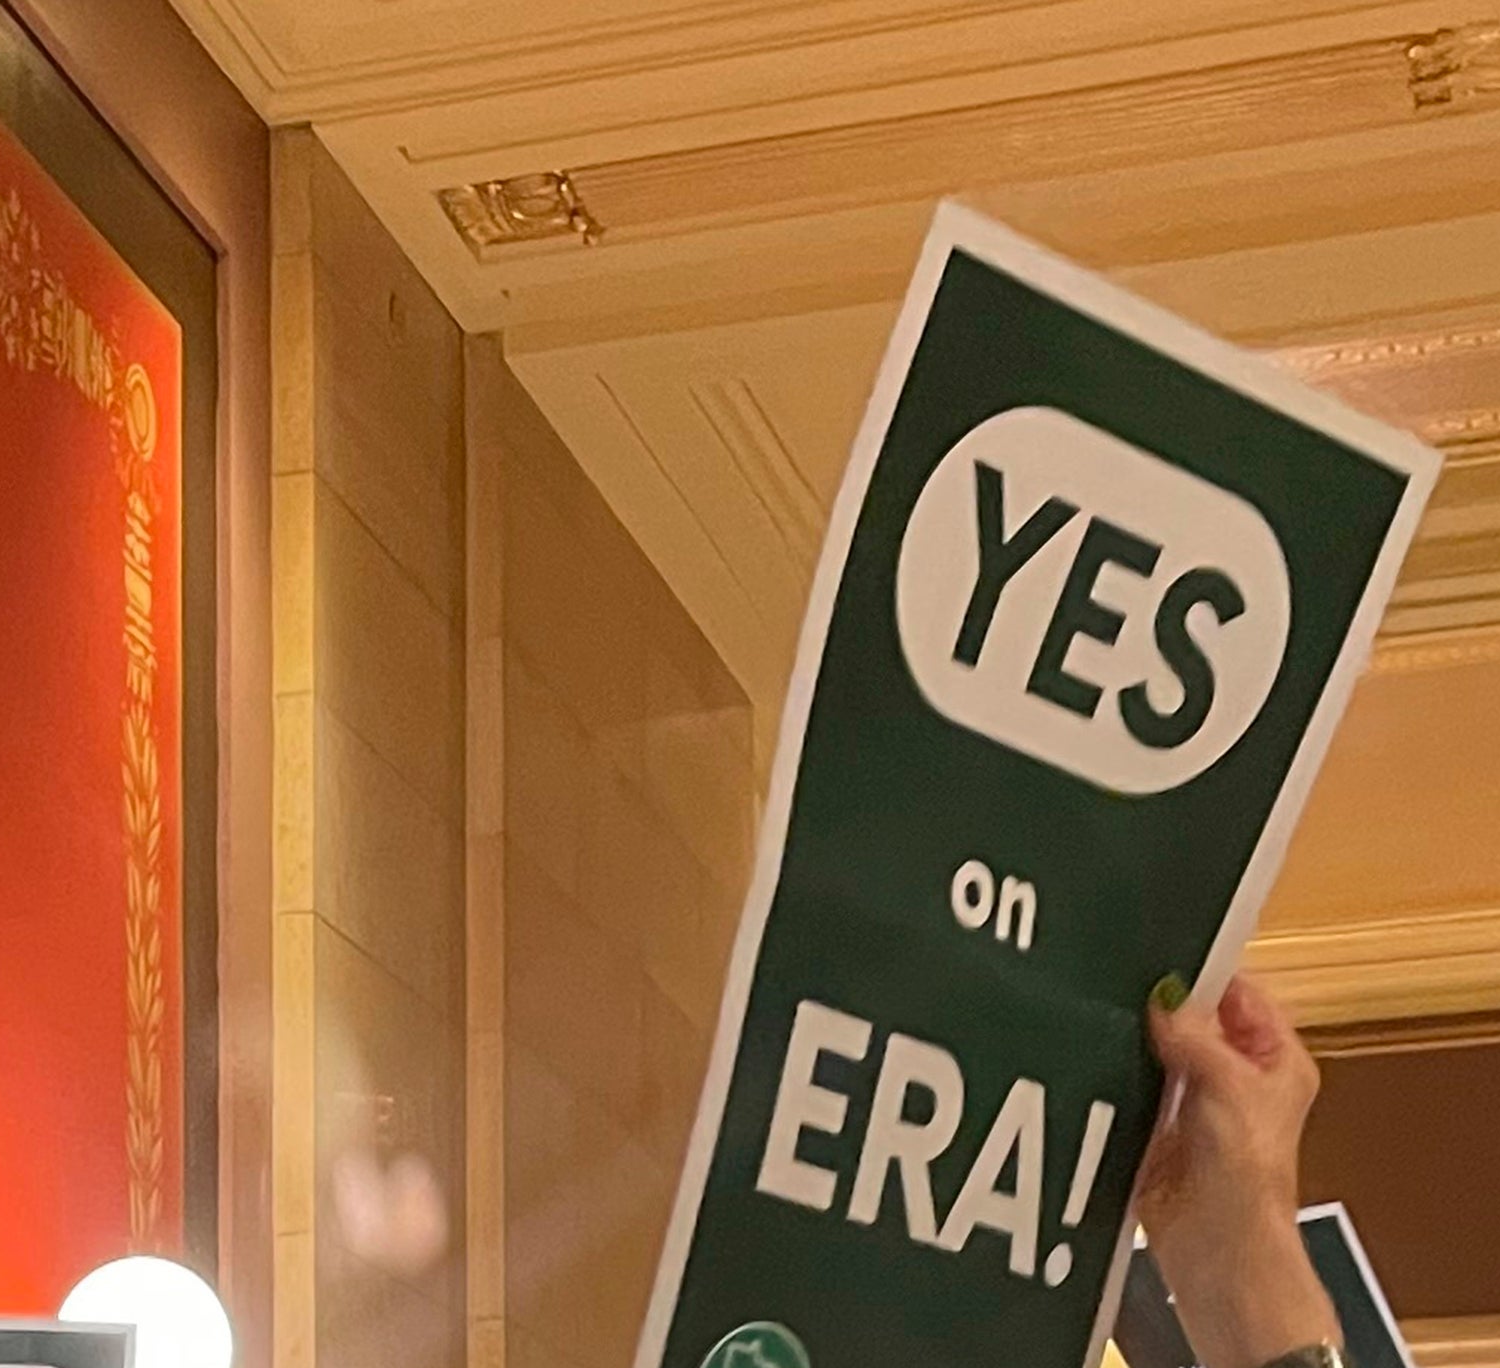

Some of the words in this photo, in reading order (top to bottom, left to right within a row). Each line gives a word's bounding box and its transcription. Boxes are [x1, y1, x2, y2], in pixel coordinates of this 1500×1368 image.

[952, 459, 1247, 751] YES
[950, 858, 1037, 950] on
[755, 998, 1117, 1288] ERA!
